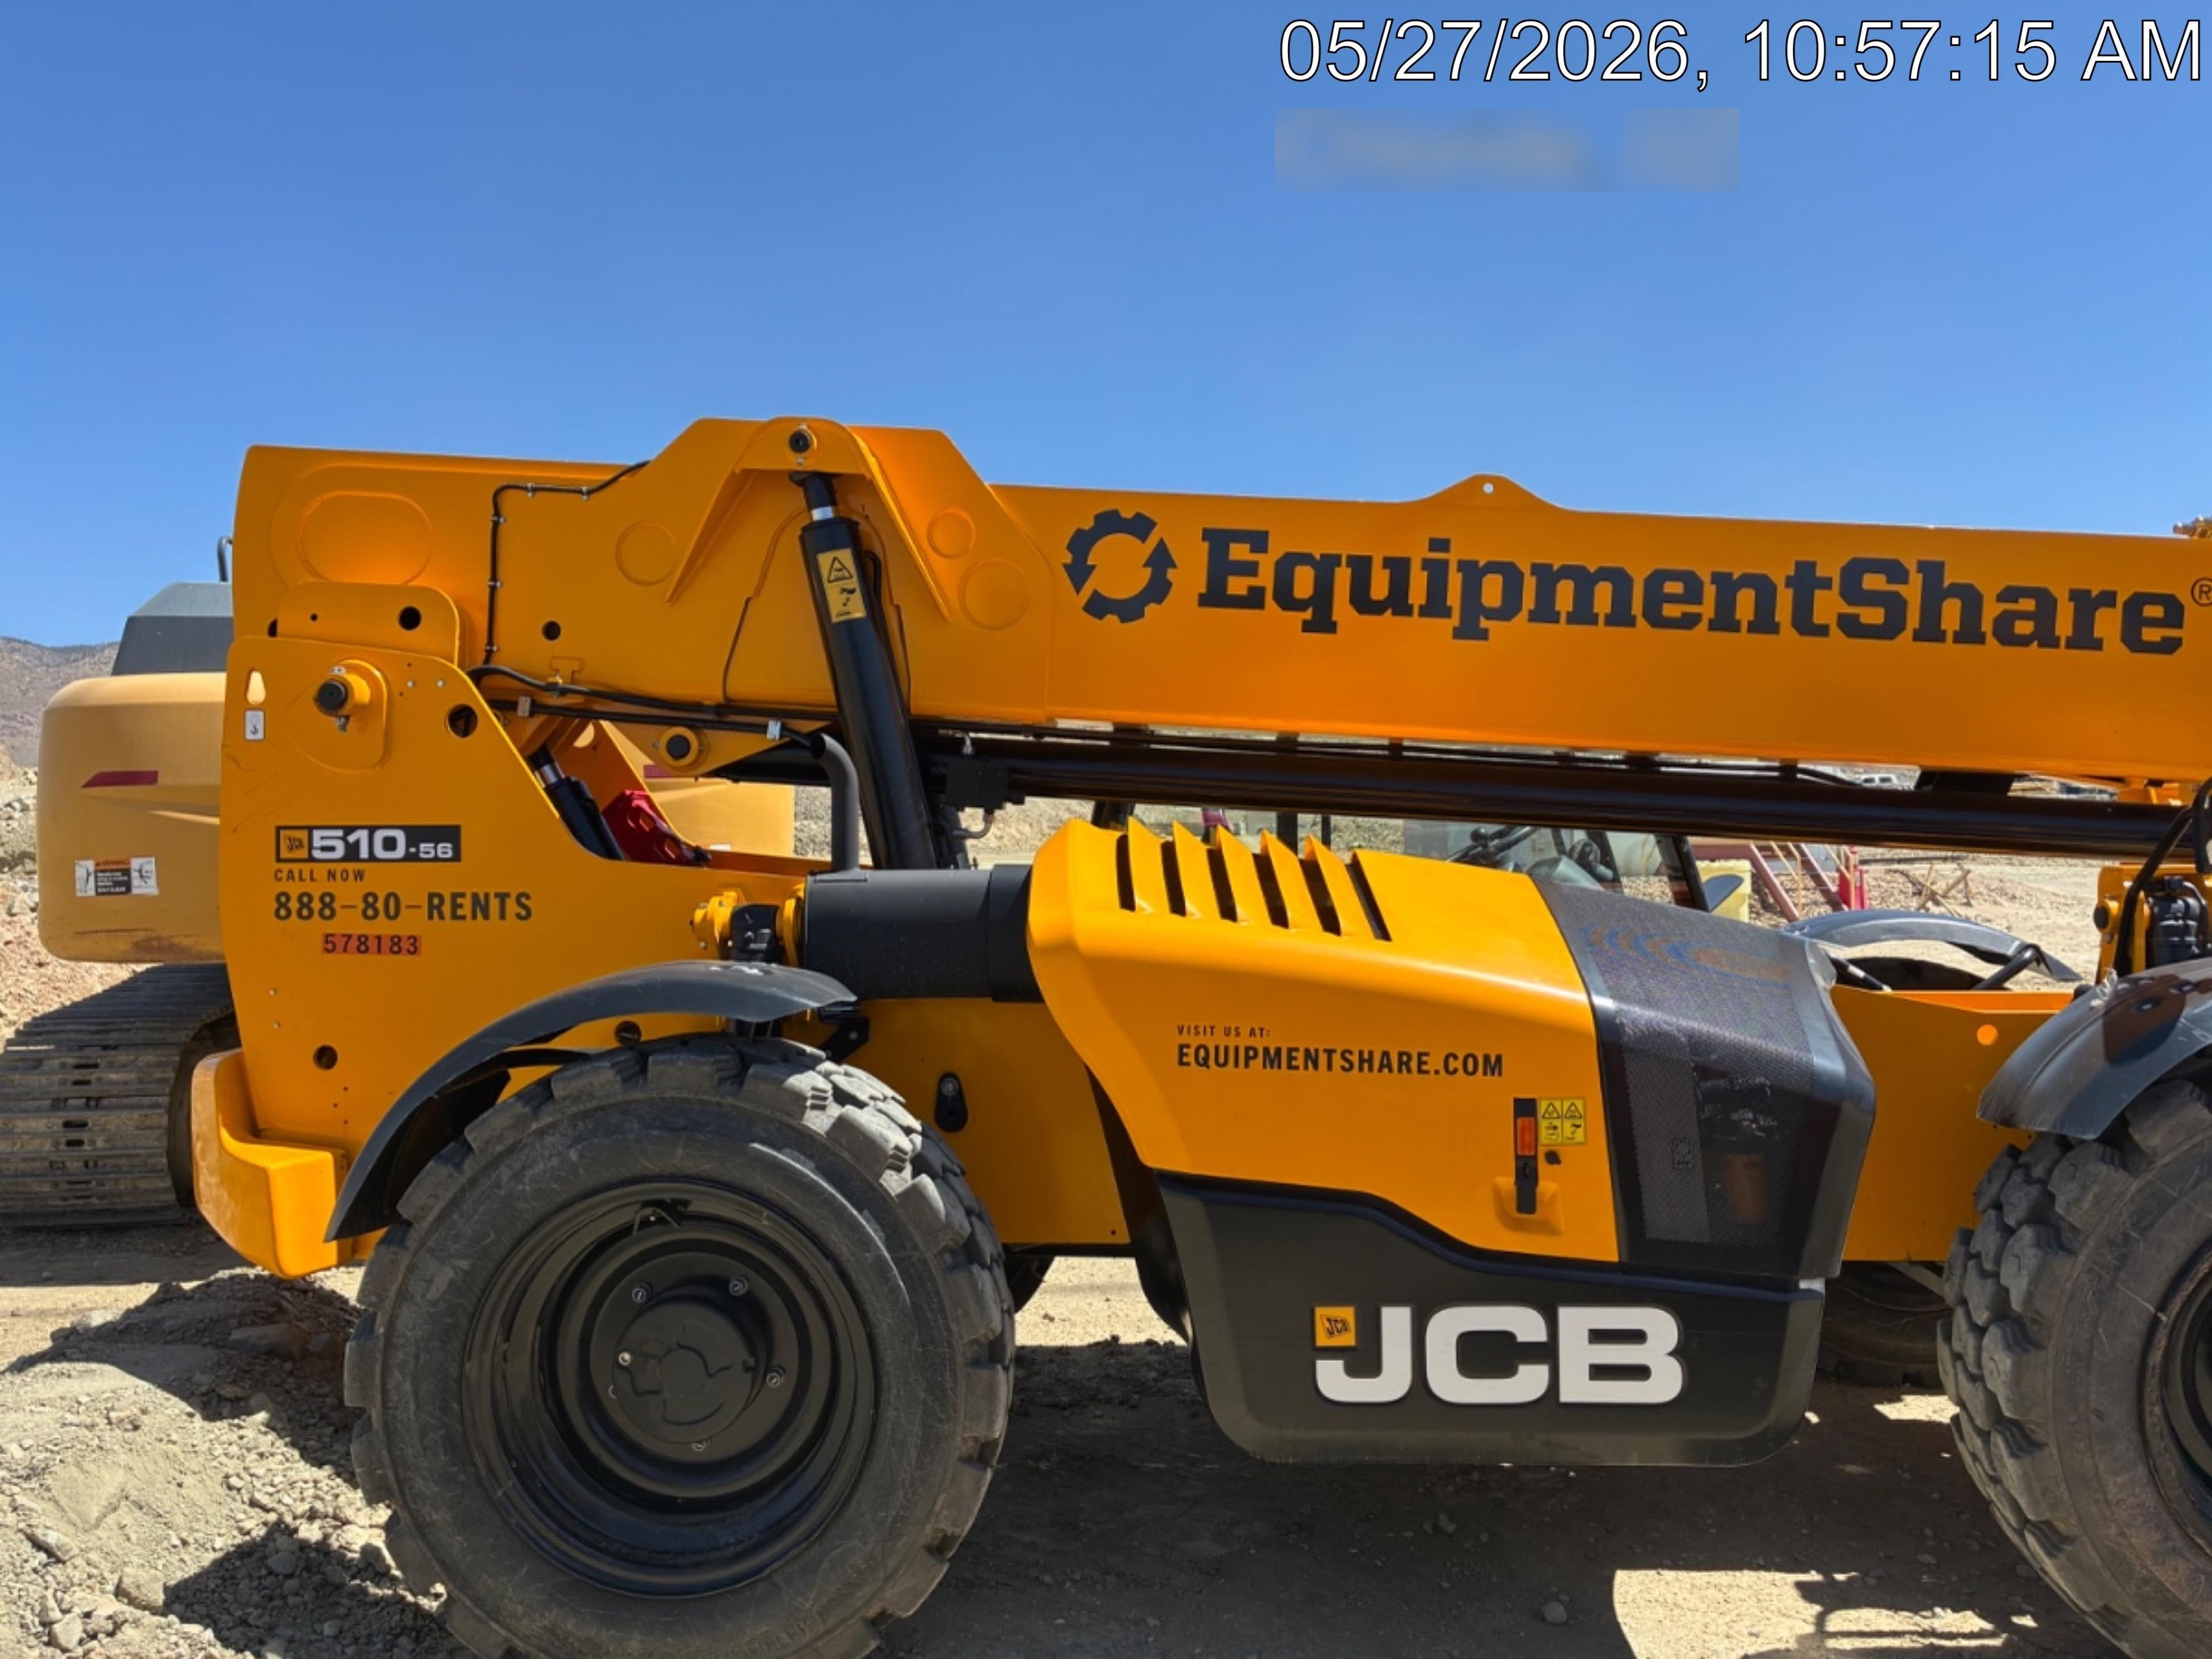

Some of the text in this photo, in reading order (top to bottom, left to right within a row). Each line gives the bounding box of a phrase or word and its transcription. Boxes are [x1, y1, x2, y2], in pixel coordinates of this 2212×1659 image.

[311, 829, 453, 860] 510-56
[275, 869, 365, 882] CALL NOW
[274, 892, 532, 921] 888-80-RENTS
[324, 933, 418, 955] 578183
[1178, 1025, 1271, 1038] VISIT US AT:
[1177, 1043, 1503, 1077] EQUIPMENTSHARE.COM
[1316, 1306, 1683, 1404] JCB
